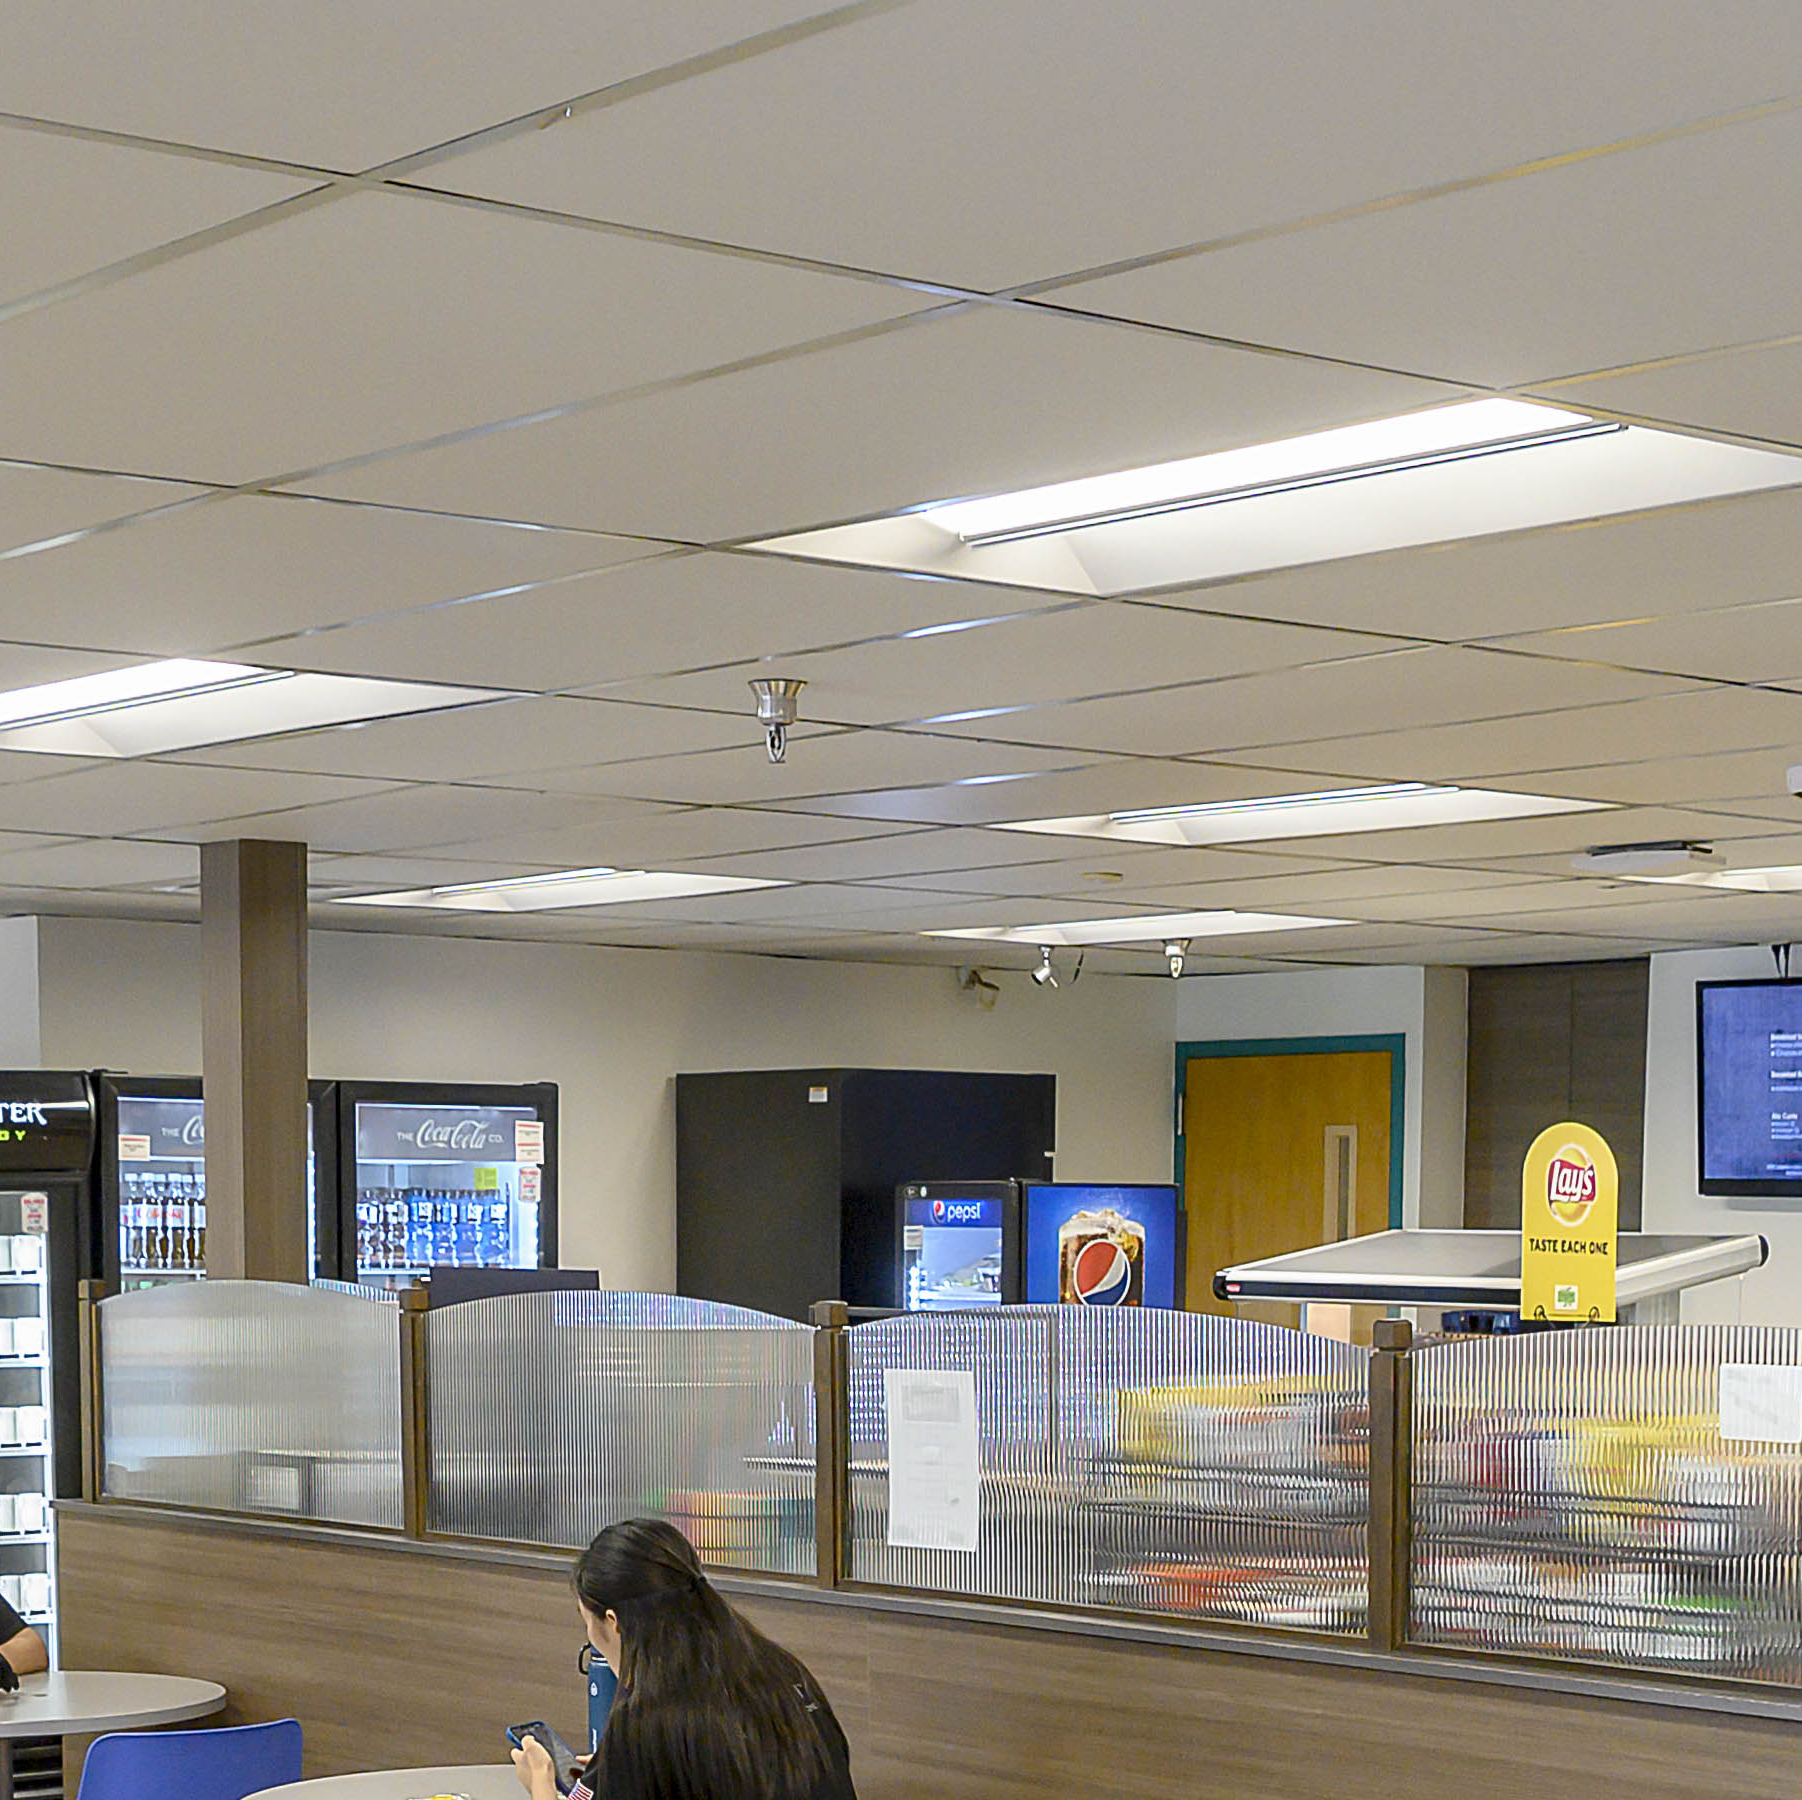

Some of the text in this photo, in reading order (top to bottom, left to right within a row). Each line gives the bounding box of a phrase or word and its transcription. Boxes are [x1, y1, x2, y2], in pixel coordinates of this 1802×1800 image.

[161, 1127, 179, 1137] THE
[397, 1132, 414, 1141] THE
[1550, 1162, 1594, 1202] Lay's
[947, 1202, 981, 1222] pepsi
[1529, 1238, 1609, 1255] TASTE EACH ONE
